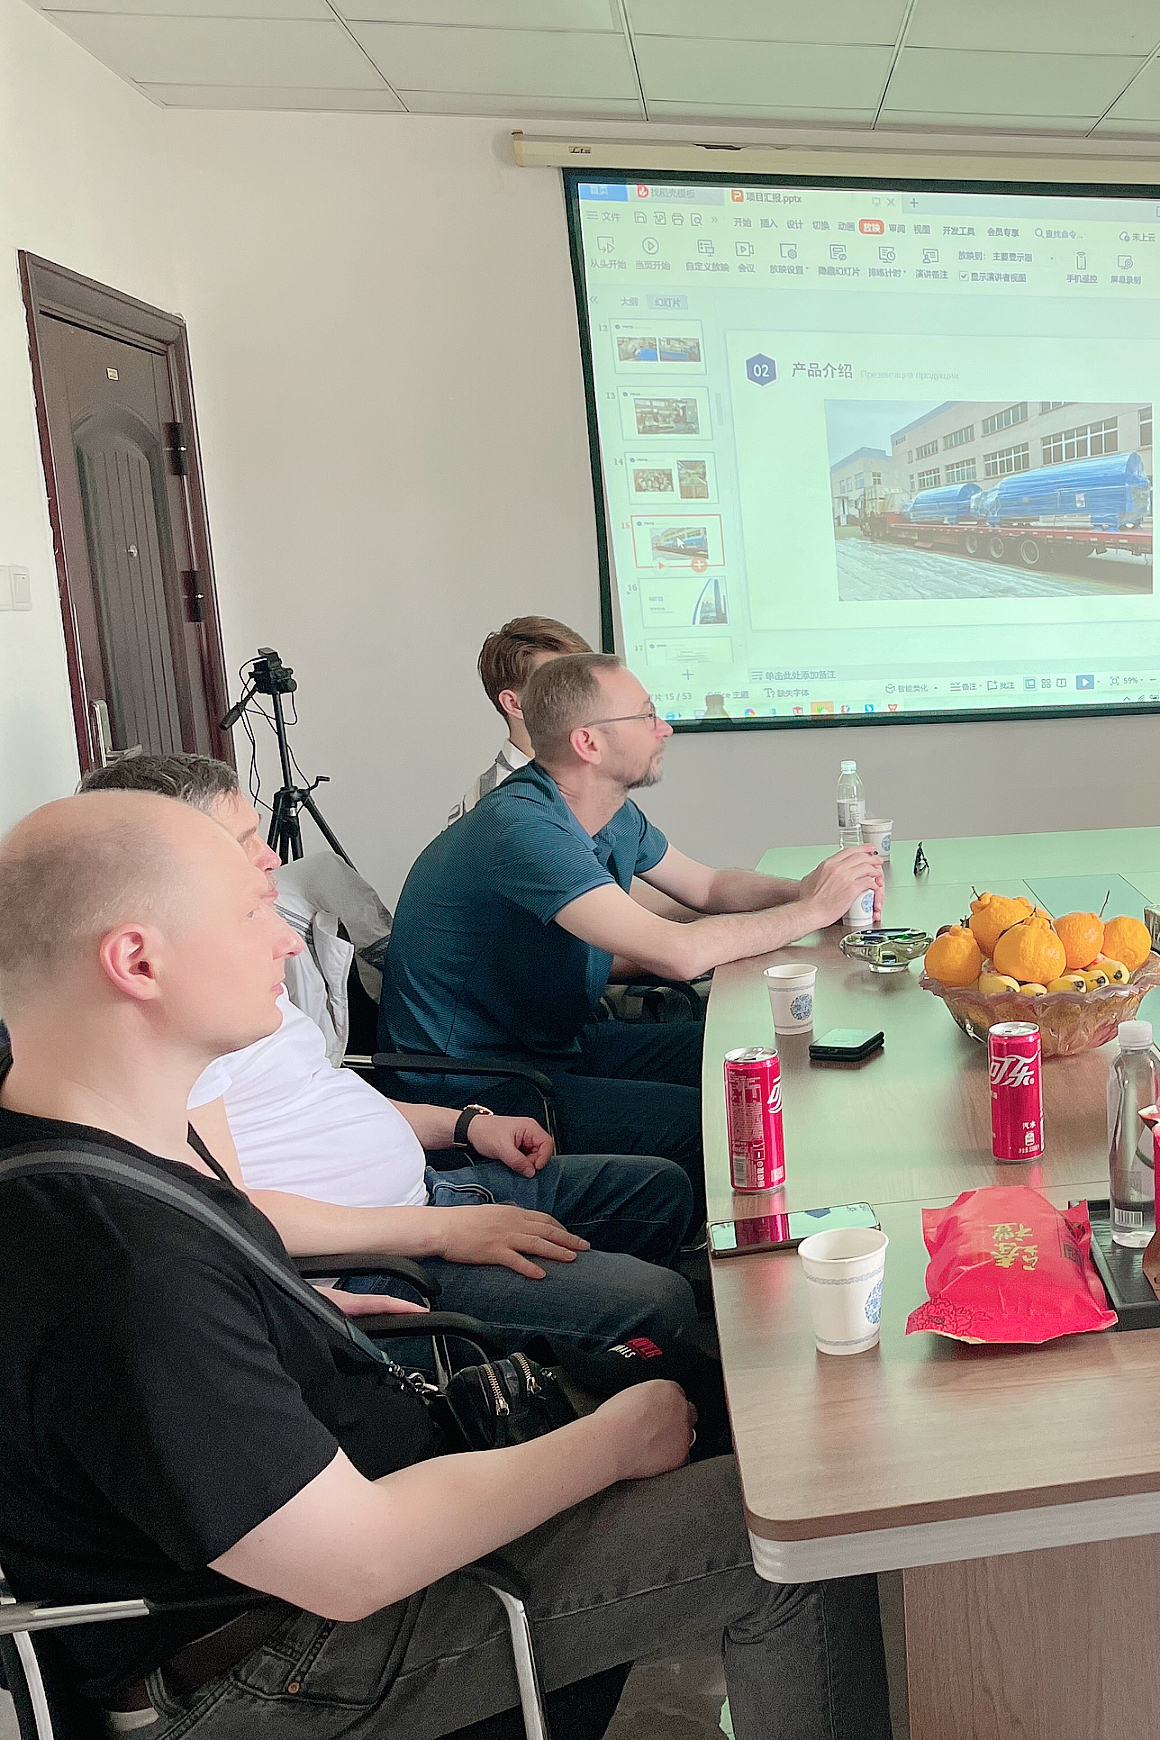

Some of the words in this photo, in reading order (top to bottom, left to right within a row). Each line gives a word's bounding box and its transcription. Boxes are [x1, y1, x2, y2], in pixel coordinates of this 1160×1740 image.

[746, 192, 802, 205] 项目汇报.pptx
[601, 211, 621, 222] 文件
[733, 217, 752, 228] 开始
[760, 218, 778, 229] 插入
[786, 219, 804, 230] 设计
[812, 220, 830, 231] 切换
[838, 221, 856, 232] 动画
[889, 223, 906, 234] 审阅
[914, 224, 931, 235] 视图
[942, 226, 976, 237] 开发工具
[987, 227, 1020, 238] 会员专享
[992, 252, 1033, 263] 主要显示器
[590, 258, 627, 270] 从头开始
[635, 260, 671, 271] 当页开始
[685, 261, 730, 273] 自定义放映
[738, 263, 756, 274] 会议
[769, 264, 804, 275] 放映设置
[818, 266, 860, 278] 隐藏幻灯片
[868, 267, 902, 279] 排练计时
[915, 268, 949, 280] 演讲备注
[971, 272, 1027, 283] 显示演讲者视图
[1066, 274, 1098, 284] 手机遥控
[1110, 275, 1142, 285] 屏幕录制
[655, 297, 682, 308] 幻灯片
[598, 323, 608, 333] 12
[753, 363, 770, 378] 02
[791, 361, 853, 379] 产品介绍
[605, 390, 616, 401] 13
[613, 457, 624, 467] 14
[765, 669, 837, 681] 单击此处添加备注
[1123, 677, 1139, 685] 59%
[776, 687, 810, 698] 缺失字体
[897, 683, 929, 694] 智能美化
[665, 692, 675, 701] 15
[682, 692, 693, 700] 53
[732, 691, 750, 700] 主题
